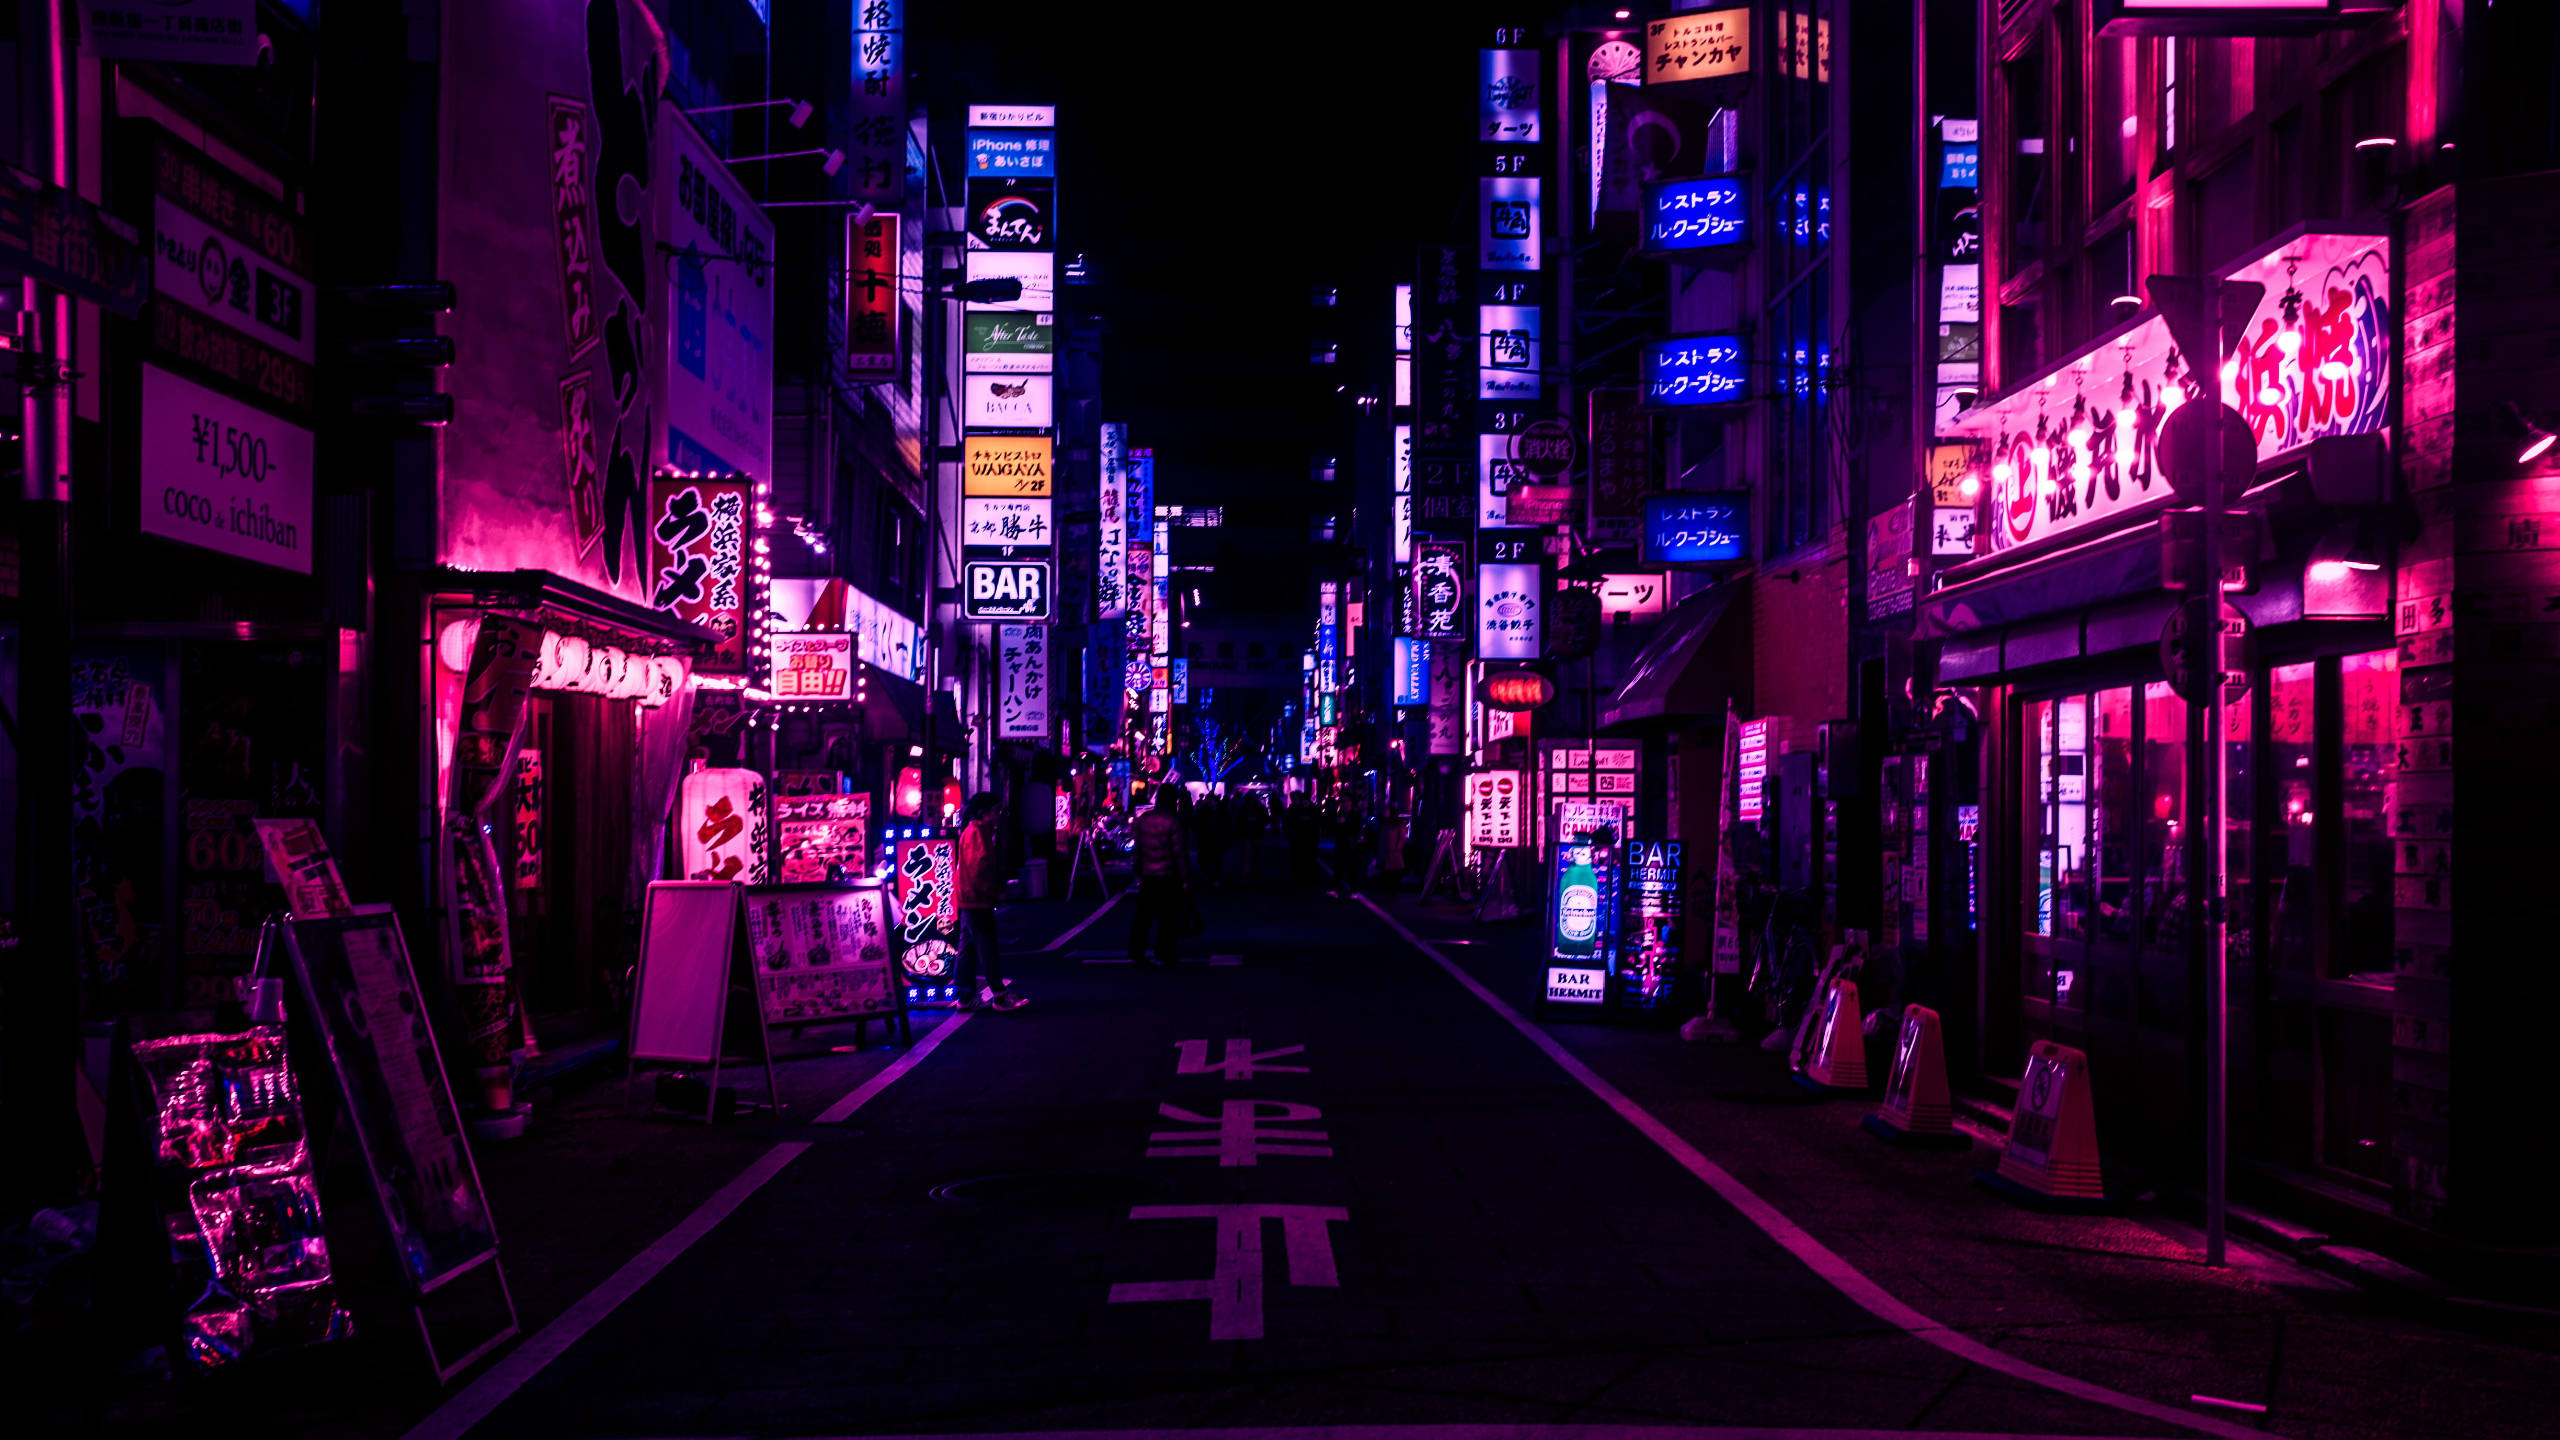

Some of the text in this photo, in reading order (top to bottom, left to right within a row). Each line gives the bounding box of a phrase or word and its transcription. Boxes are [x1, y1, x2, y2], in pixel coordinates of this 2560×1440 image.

[1494, 27, 1526, 44] 6F
[1649, 23, 1666, 36] 3F
[1655, 45, 1743, 71] チャンカヤ
[1486, 121, 1534, 138] ダーツ
[972, 138, 1022, 152] iPhone
[1494, 155, 1525, 172] 5F
[1658, 189, 1738, 212] レストラン
[553, 116, 593, 335] 煮込み
[679, 155, 766, 288] お部屋探しなら
[984, 206, 1042, 245] まんてん
[1494, 284, 1525, 301] 4F
[269, 283, 295, 330] 3F
[984, 322, 1012, 352] After
[1658, 346, 1738, 368] レストラン
[191, 413, 276, 482] ¥1,500-
[972, 450, 1042, 461] チキンビストロ
[1524, 436, 1571, 460] 消火栓
[2047, 377, 2172, 523] 磯丸水
[971, 463, 1046, 477] WAIGAYA
[1030, 480, 1046, 491] 2F
[164, 486, 212, 525] coco
[229, 496, 298, 550] ichiban
[1661, 505, 1734, 522] レストラン
[709, 490, 742, 611] 横浜家系
[1494, 542, 1525, 560] 2F
[973, 567, 1041, 600] BAR
[1591, 584, 1654, 605] ーツ
[776, 668, 848, 695] 自由!!
[1003, 646, 1023, 723] チャーハン
[1628, 841, 1682, 867] BAR
[1630, 868, 1678, 881] HERMIT
[1557, 972, 1590, 985] BAR
[1548, 987, 1602, 1000] HERMIT
